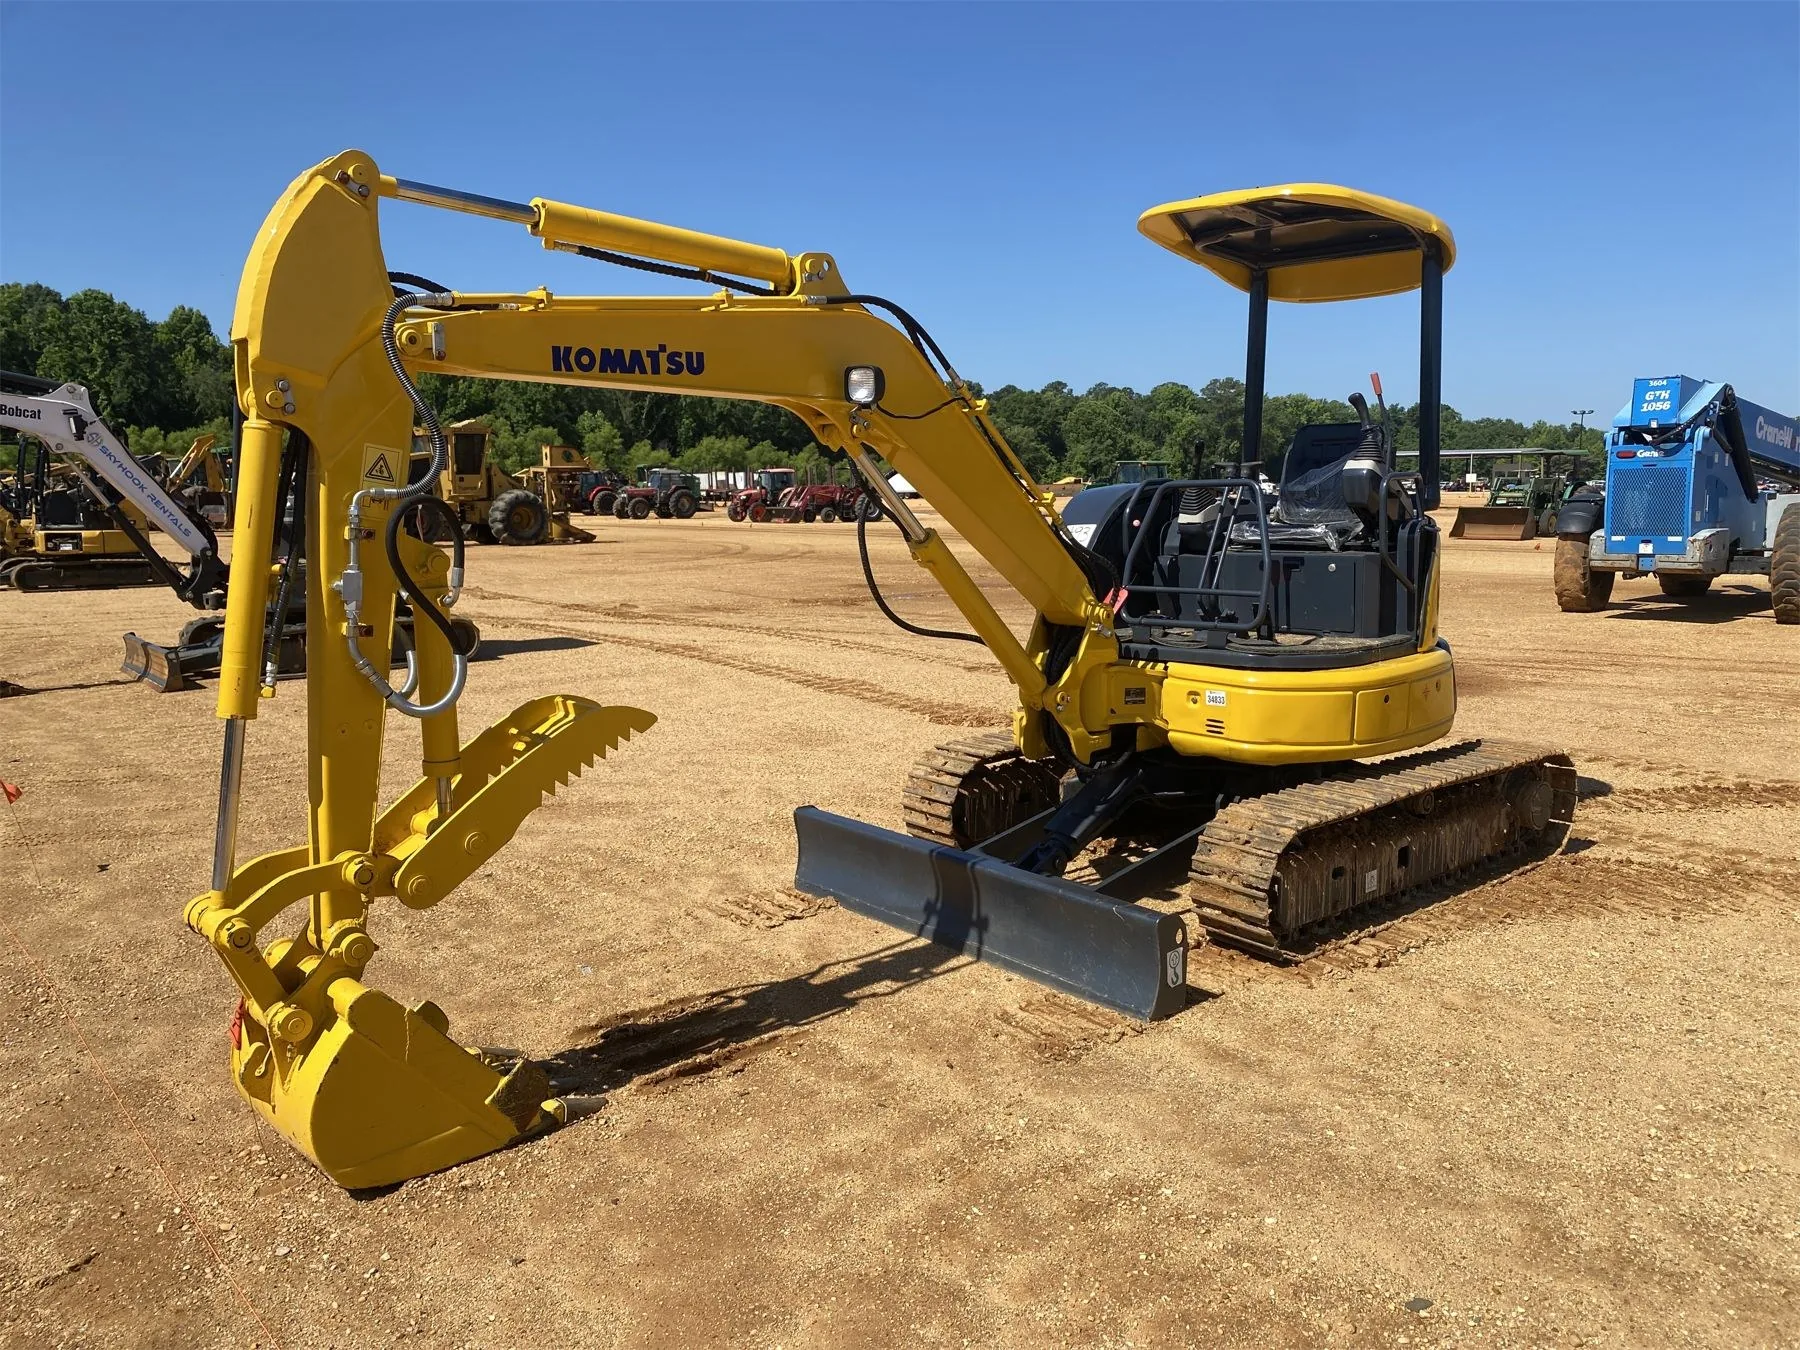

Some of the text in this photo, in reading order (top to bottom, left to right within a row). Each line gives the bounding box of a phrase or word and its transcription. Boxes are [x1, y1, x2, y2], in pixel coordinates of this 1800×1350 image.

[551, 344, 705, 376] KOMATSU
[1648, 379, 1667, 387] 3604
[0, 403, 41, 420] Bobcat
[1640, 401, 1671, 412] 1056
[1636, 449, 1665, 458] Genie
[99, 445, 192, 538] SKYHOOK RENTALS
